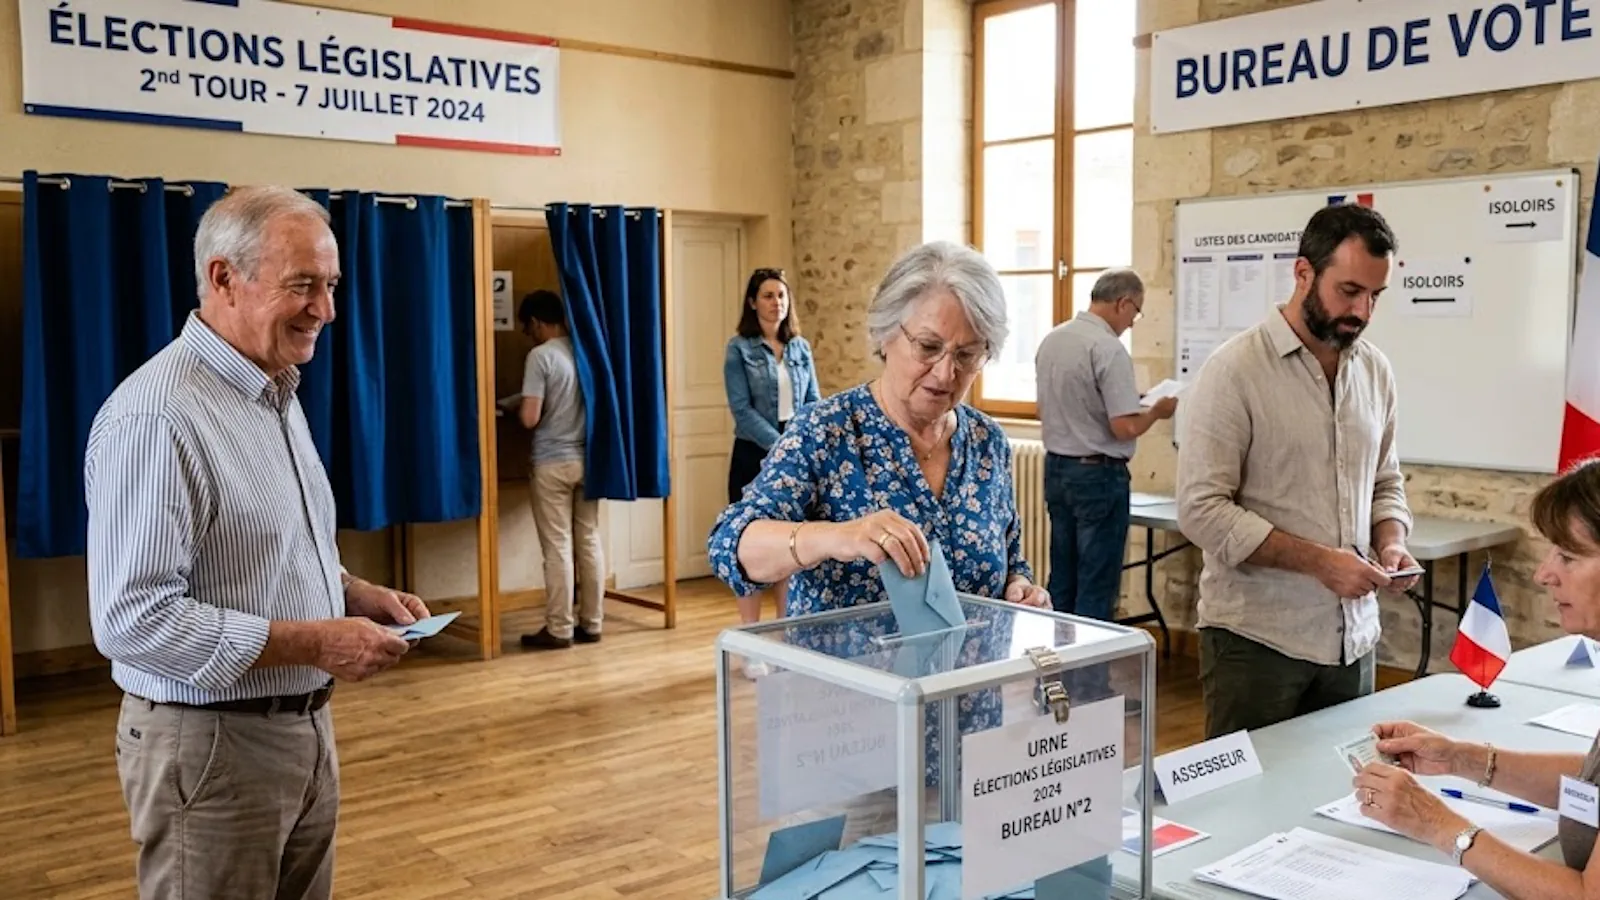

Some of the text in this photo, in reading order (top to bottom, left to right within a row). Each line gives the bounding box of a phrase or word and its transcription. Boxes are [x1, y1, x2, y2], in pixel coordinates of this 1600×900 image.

[50, 1, 541, 95] ÉLECTIONS LÉGISLATIVES
[1176, 0, 1592, 99] BUREAU DE VOTE
[140, 69, 180, 92] 2nd
[189, 73, 267, 103] TOUR
[294, 84, 309, 107] 7
[318, 87, 418, 117] JUILLET
[427, 98, 485, 123] 2024
[1488, 198, 1556, 215] ISOLOIRS
[1195, 235, 1225, 247] LISTES
[1227, 234, 1246, 245] DES
[1403, 275, 1464, 289] ISOLOIRS
[1028, 732, 1068, 758] URNE
[973, 744, 1116, 798] ÉLECTIONS LÉGISLATIVES
[1172, 749, 1247, 785] ASSESSEUR
[1033, 782, 1062, 802] 2024
[1001, 797, 1092, 839] BUREAU N°2
